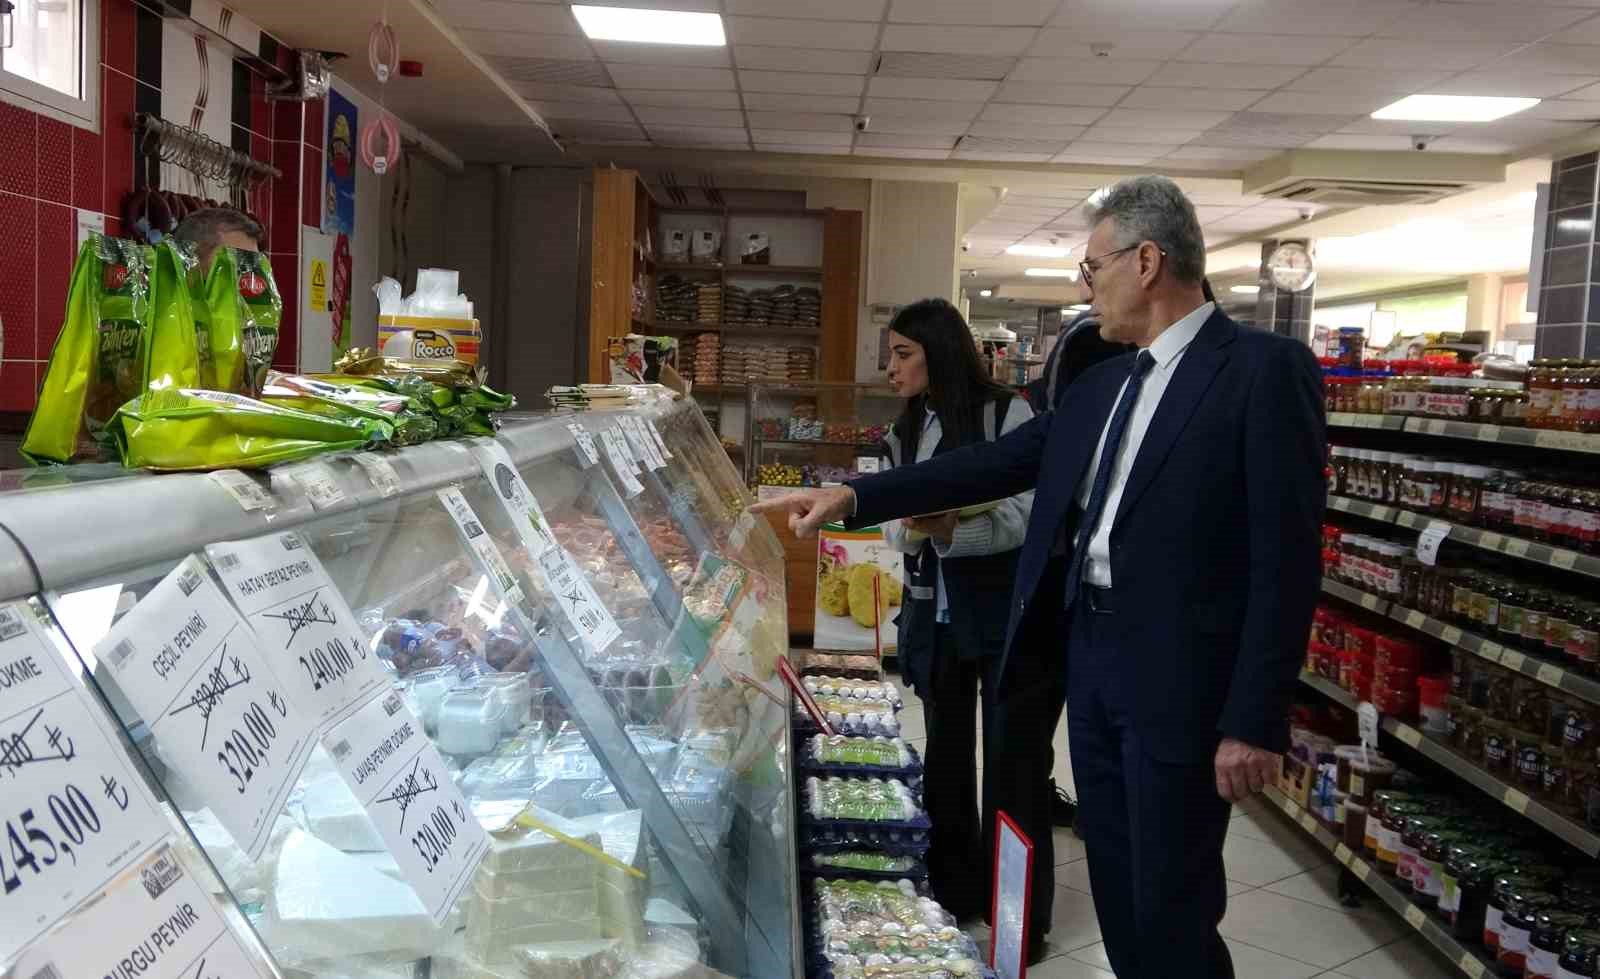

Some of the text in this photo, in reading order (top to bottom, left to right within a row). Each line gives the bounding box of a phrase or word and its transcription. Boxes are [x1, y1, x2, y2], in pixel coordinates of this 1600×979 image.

[415, 341, 454, 358] Rocco
[238, 576, 268, 596] HATAY
[264, 568, 290, 587] BEYAZ
[152, 644, 181, 681] ÇEÇİL
[176, 610, 208, 650] PEYNİRİ
[299, 636, 366, 691] 240,00 ₺
[218, 690, 287, 794] 320,00 ₺
[351, 722, 415, 785] LAVAŞ PEYNİR DÖKME
[100, 774, 129, 811] ₺
[412, 805, 457, 873] 320,00
[102, 903, 200, 979] URGU PEYNİR
